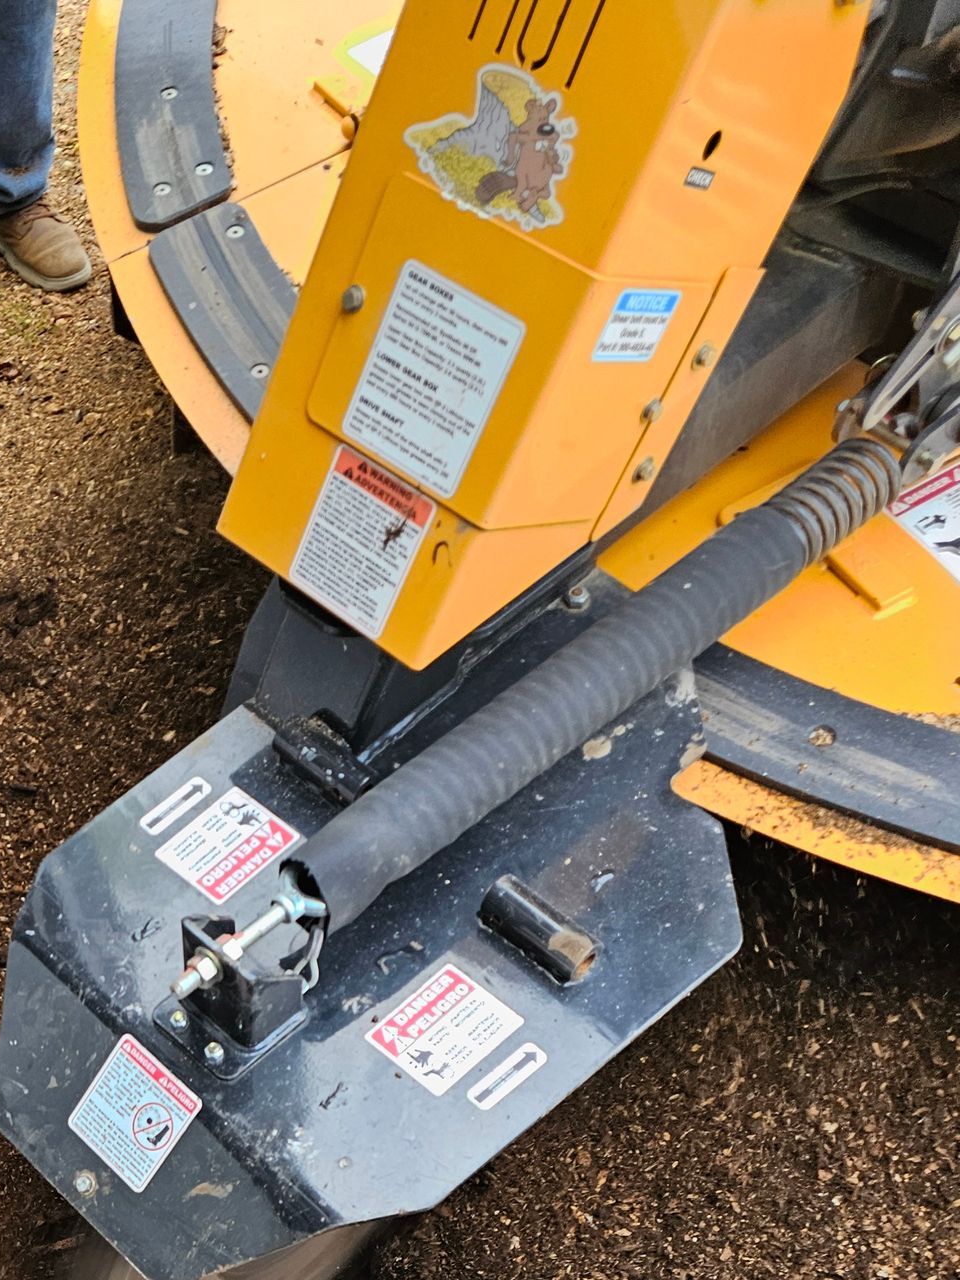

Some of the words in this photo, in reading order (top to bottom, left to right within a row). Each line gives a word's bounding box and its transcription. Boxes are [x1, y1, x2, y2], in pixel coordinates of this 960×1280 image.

[687, 169, 713, 187] CHECK
[407, 269, 428, 287] GEAR
[428, 281, 454, 302] BOXES
[625, 294, 670, 311] NOTICE
[375, 350, 401, 370] LOWER
[401, 366, 422, 383] GEAR
[422, 378, 439, 393] BOX
[358, 394, 380, 413] DRIVE
[380, 408, 404, 428] SHAFT
[368, 467, 413, 501] WARNING
[199, 835, 262, 888] PELIGRO
[213, 845, 274, 896] DANGER
[392, 973, 454, 1027] DANGER
[405, 981, 471, 1038] PELIGRO
[129, 1047, 156, 1075] DANGER
[165, 1081, 195, 1111] PELIGRO
